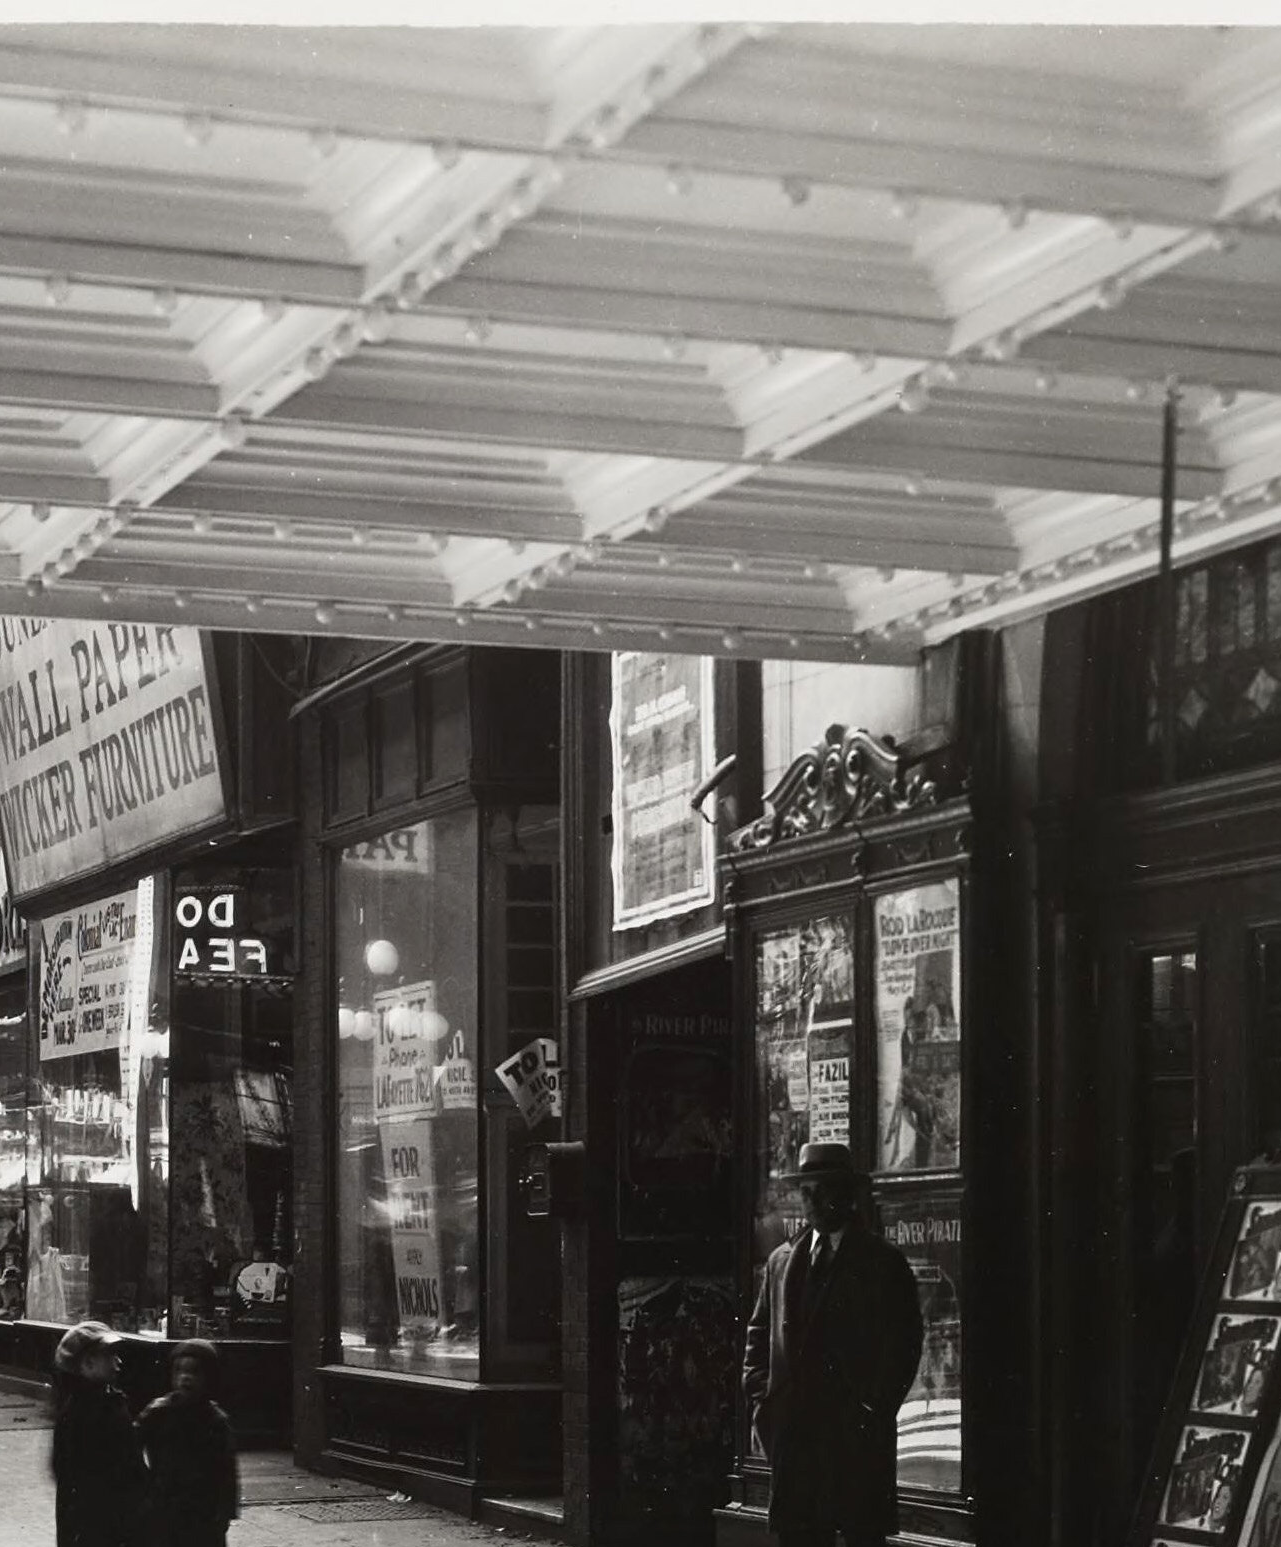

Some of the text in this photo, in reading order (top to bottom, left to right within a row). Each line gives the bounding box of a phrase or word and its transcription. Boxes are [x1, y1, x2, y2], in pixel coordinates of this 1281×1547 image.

[0, 684, 216, 861] WICKER FURNITURE
[503, 1051, 539, 1088] TO
[391, 1146, 420, 1179] FOR
